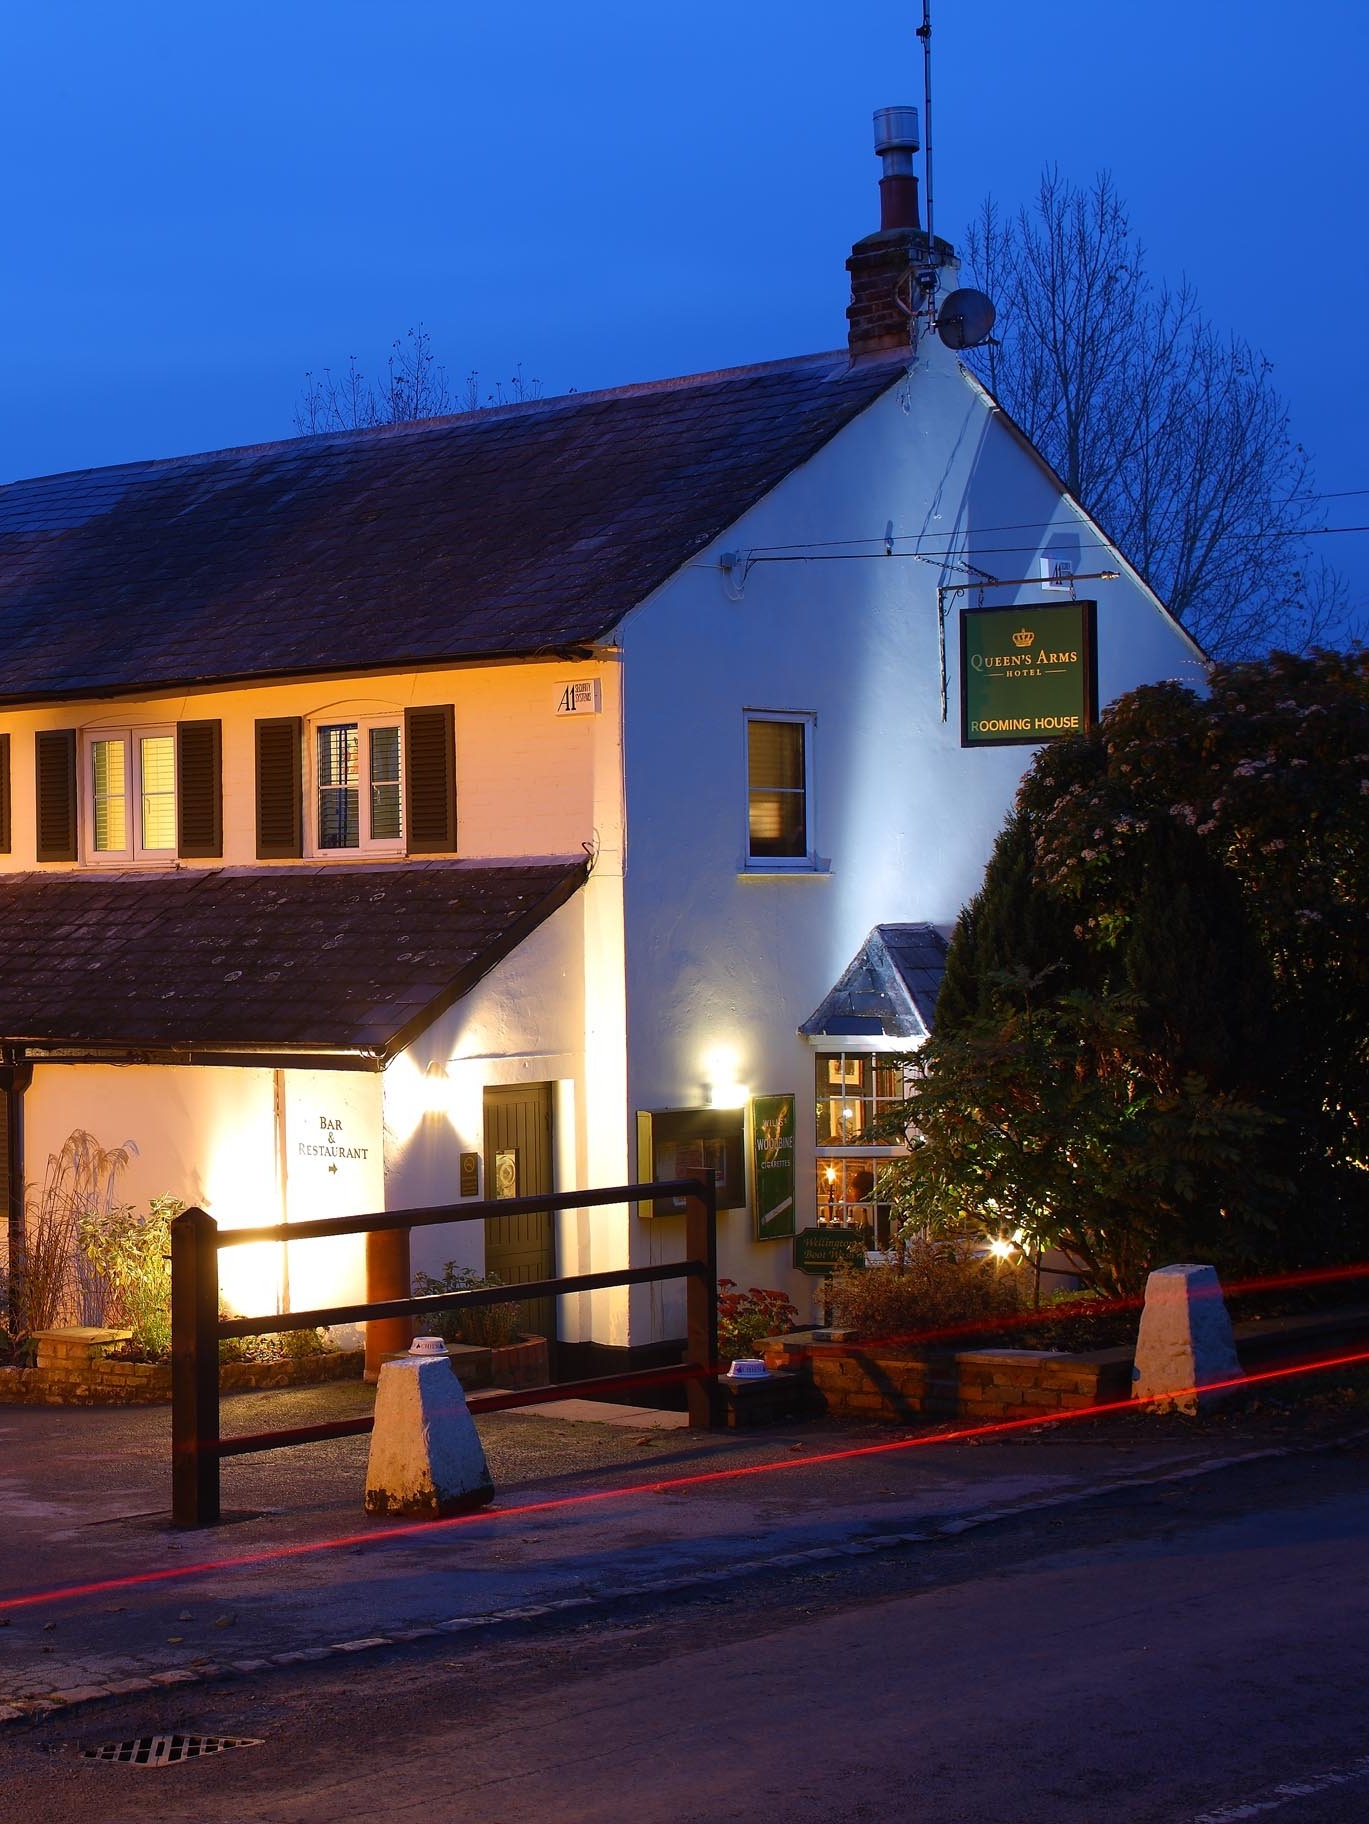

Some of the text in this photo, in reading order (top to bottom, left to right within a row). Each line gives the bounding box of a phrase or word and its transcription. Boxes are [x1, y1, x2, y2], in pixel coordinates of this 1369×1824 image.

[971, 649, 1078, 672] QUEEN'S ARMS
[1006, 668, 1042, 678] HOTEL
[558, 685, 576, 712] A1
[971, 716, 1079, 732] ROOMING HOUSE
[320, 1116, 343, 1130] BAR
[327, 1131, 336, 1144] &
[298, 1142, 368, 1160] RESTAURANT
[760, 1160, 791, 1169] CIGARETTES
